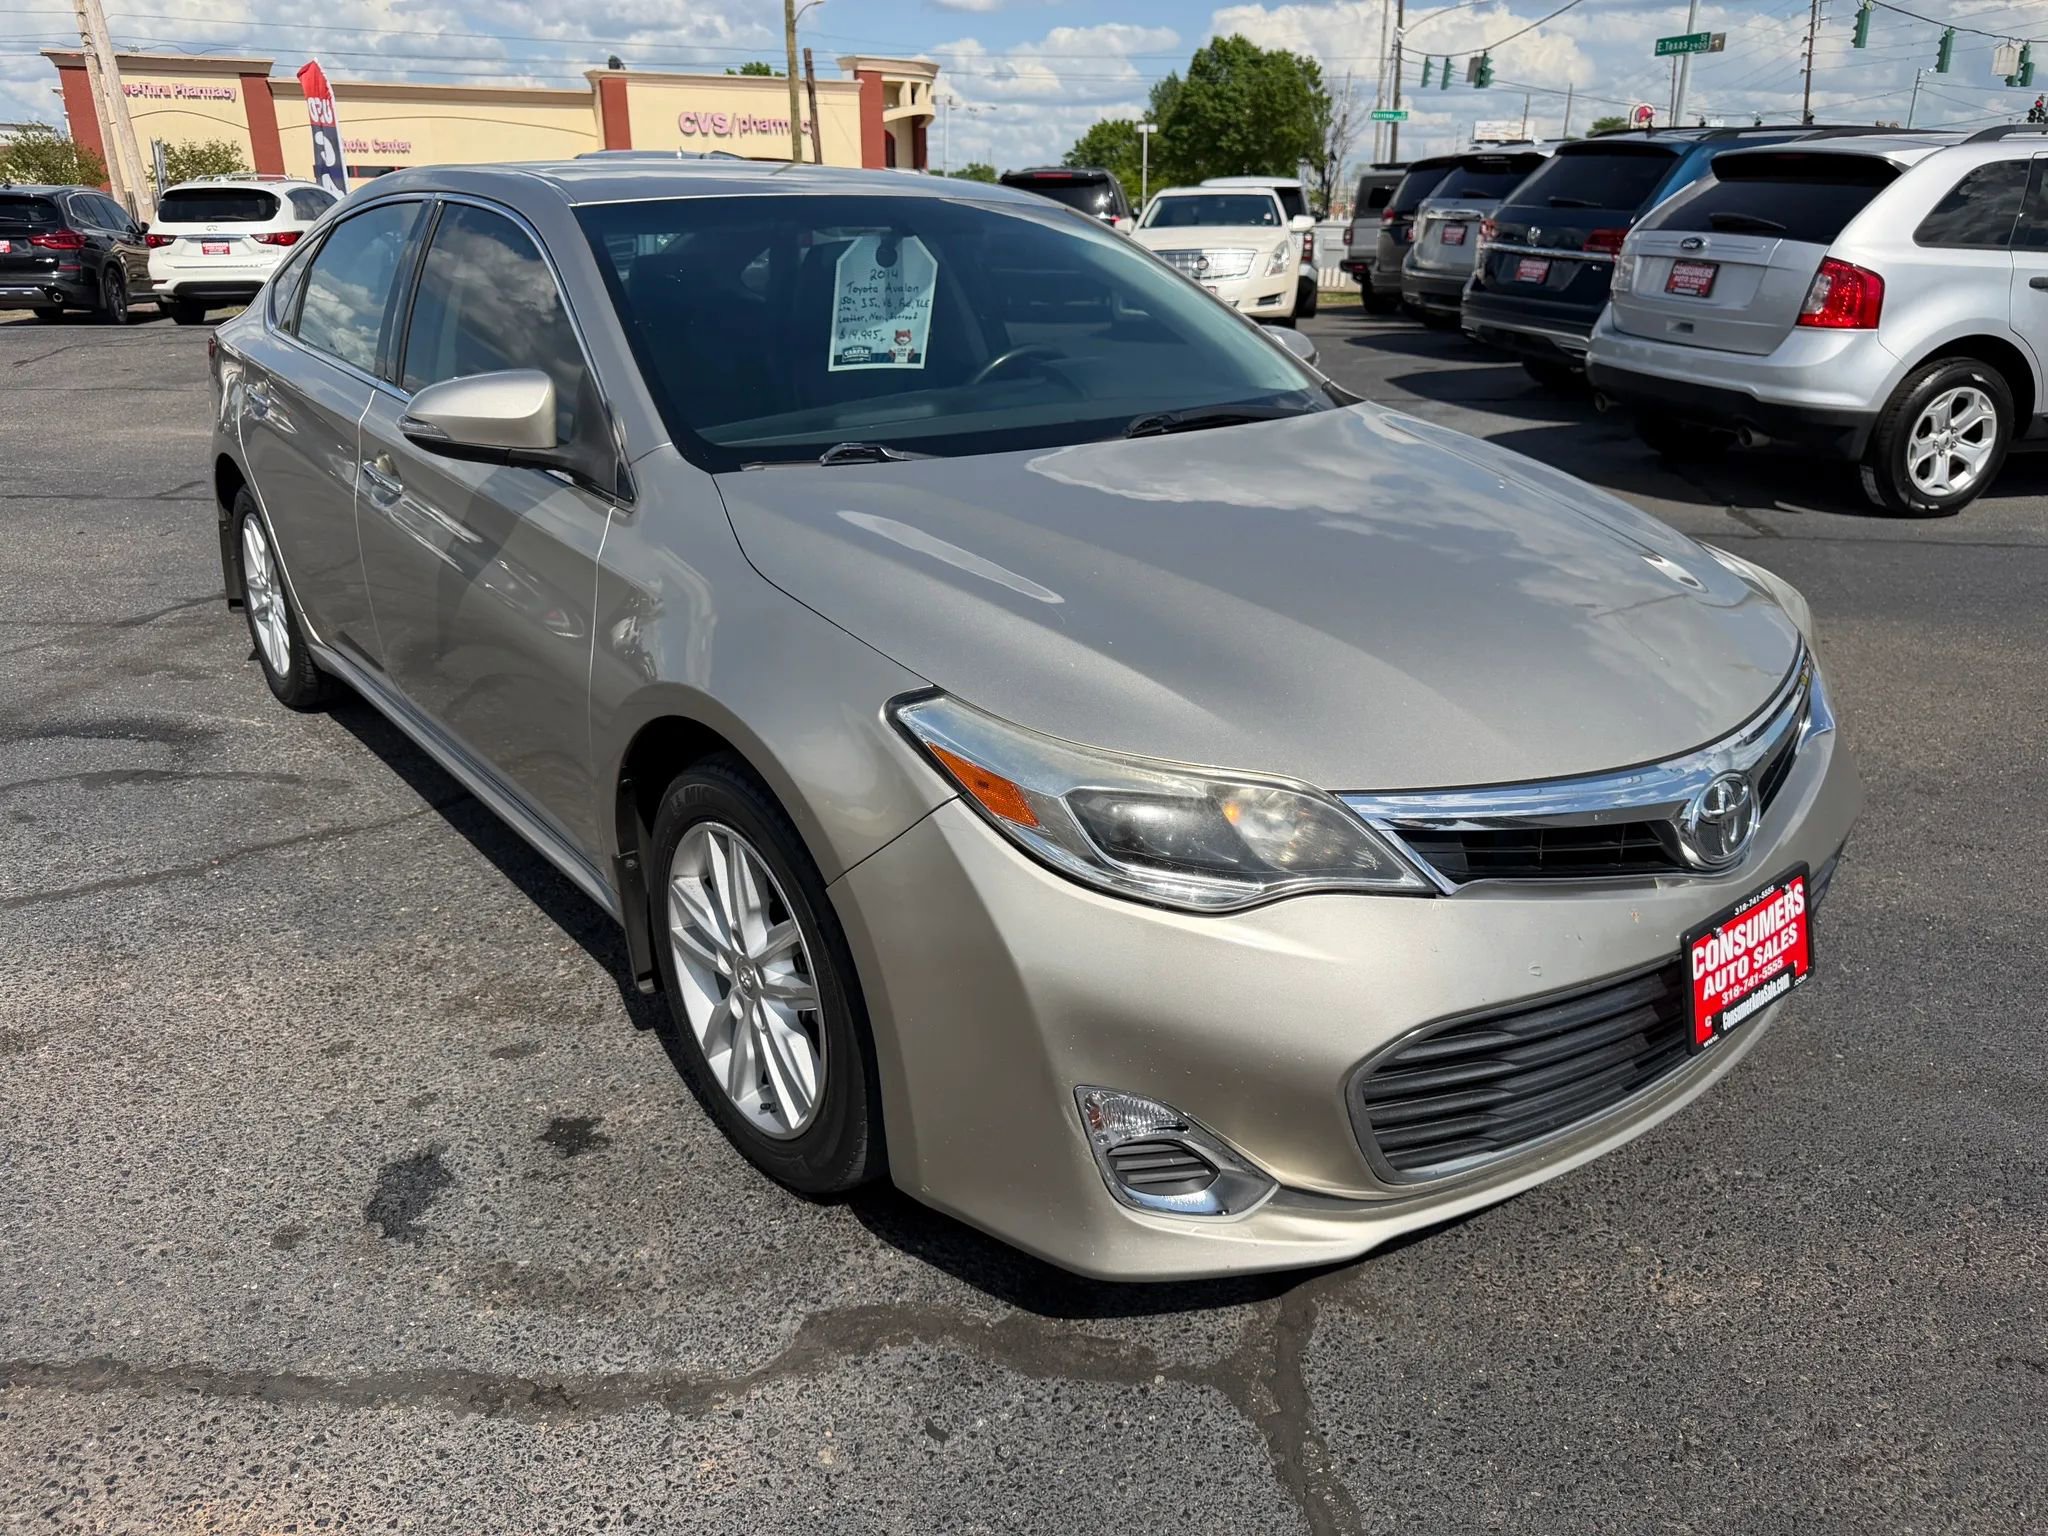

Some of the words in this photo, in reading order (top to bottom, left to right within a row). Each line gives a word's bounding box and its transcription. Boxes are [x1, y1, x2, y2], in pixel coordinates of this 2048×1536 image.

[1665, 41, 1688, 51] Texas
[121, 82, 172, 98] ve-Thru
[172, 83, 236, 103] Pharmacy
[342, 138, 369, 153] hoto
[373, 139, 411, 154] Center
[870, 268, 898, 281] 2014
[846, 281, 878, 297] Toyota
[885, 282, 919, 294] Avalon
[1734, 885, 1775, 916] 318-741-5555
[1692, 883, 1805, 981] CONSUMERS
[1703, 955, 1750, 1001] AUTO
[1753, 922, 1798, 970] SALES
[1721, 956, 1784, 1006] 318-741-5555
